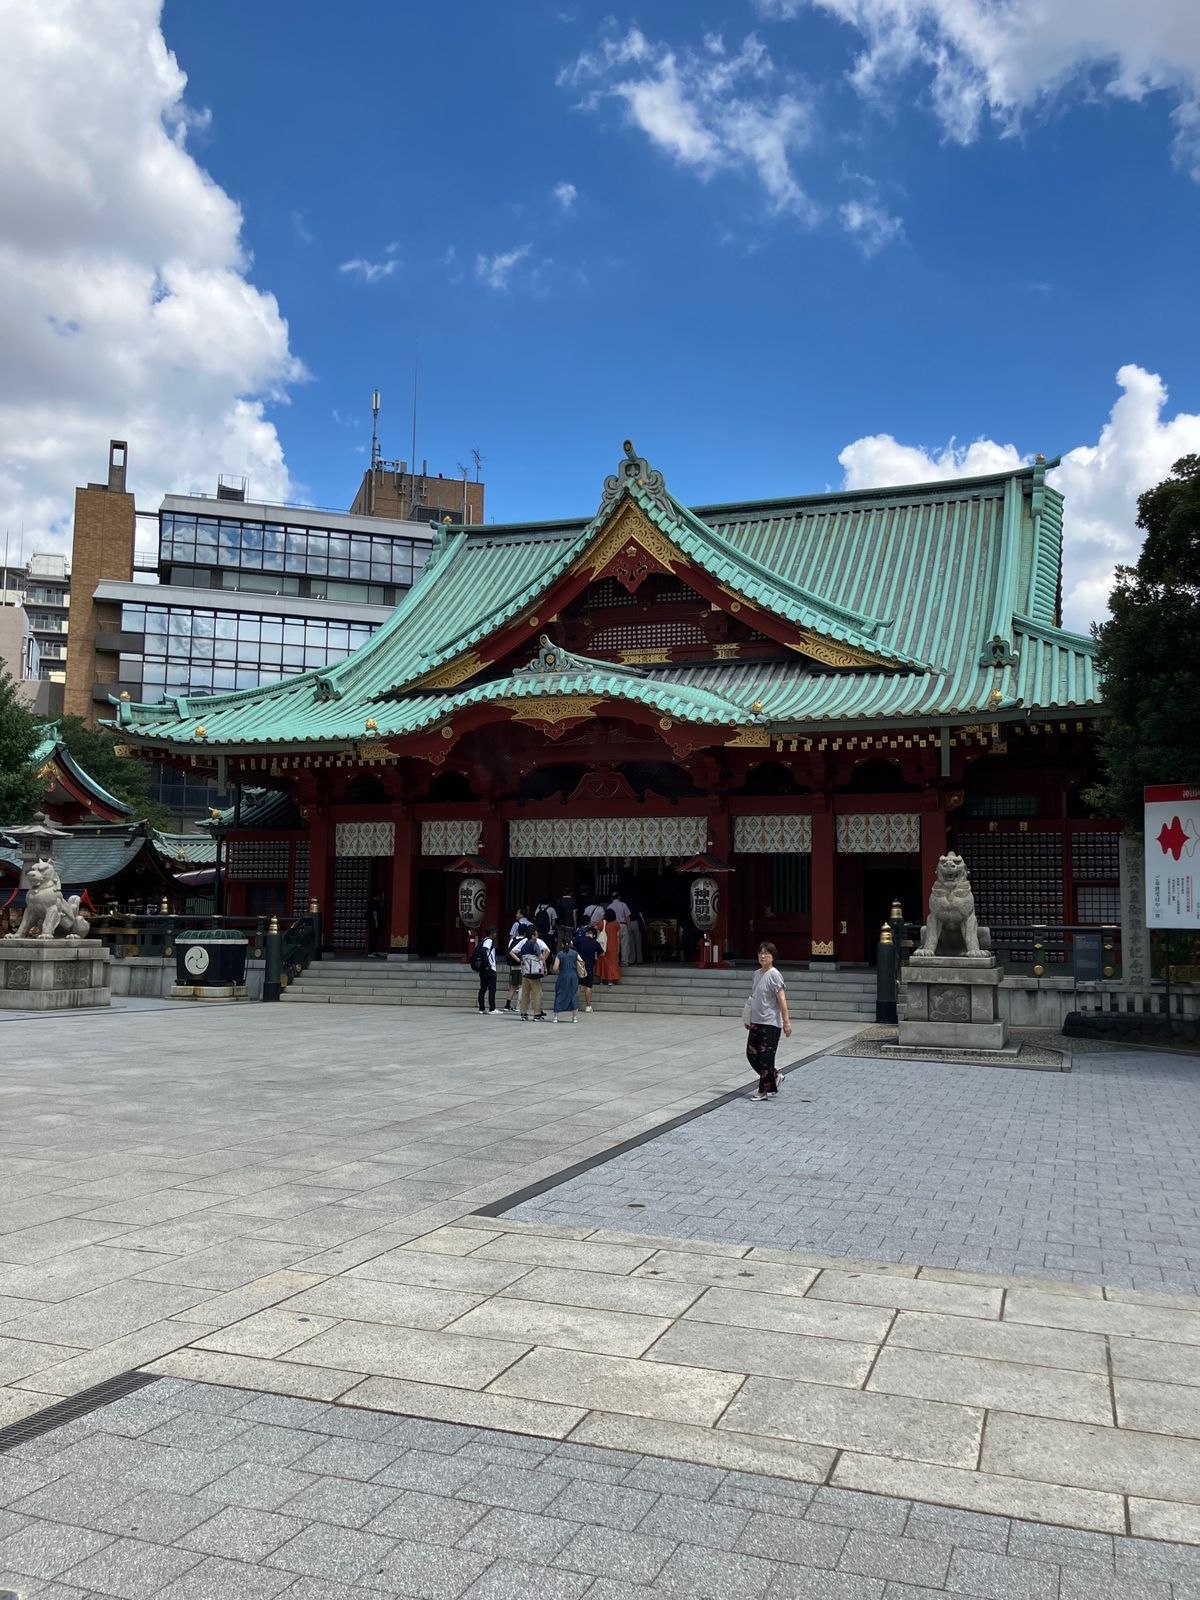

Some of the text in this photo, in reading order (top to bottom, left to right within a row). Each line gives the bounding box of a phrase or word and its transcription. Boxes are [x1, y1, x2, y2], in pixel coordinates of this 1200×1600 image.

[460, 887, 474, 919] 神田明神
[694, 888, 711, 922] 神田明神
